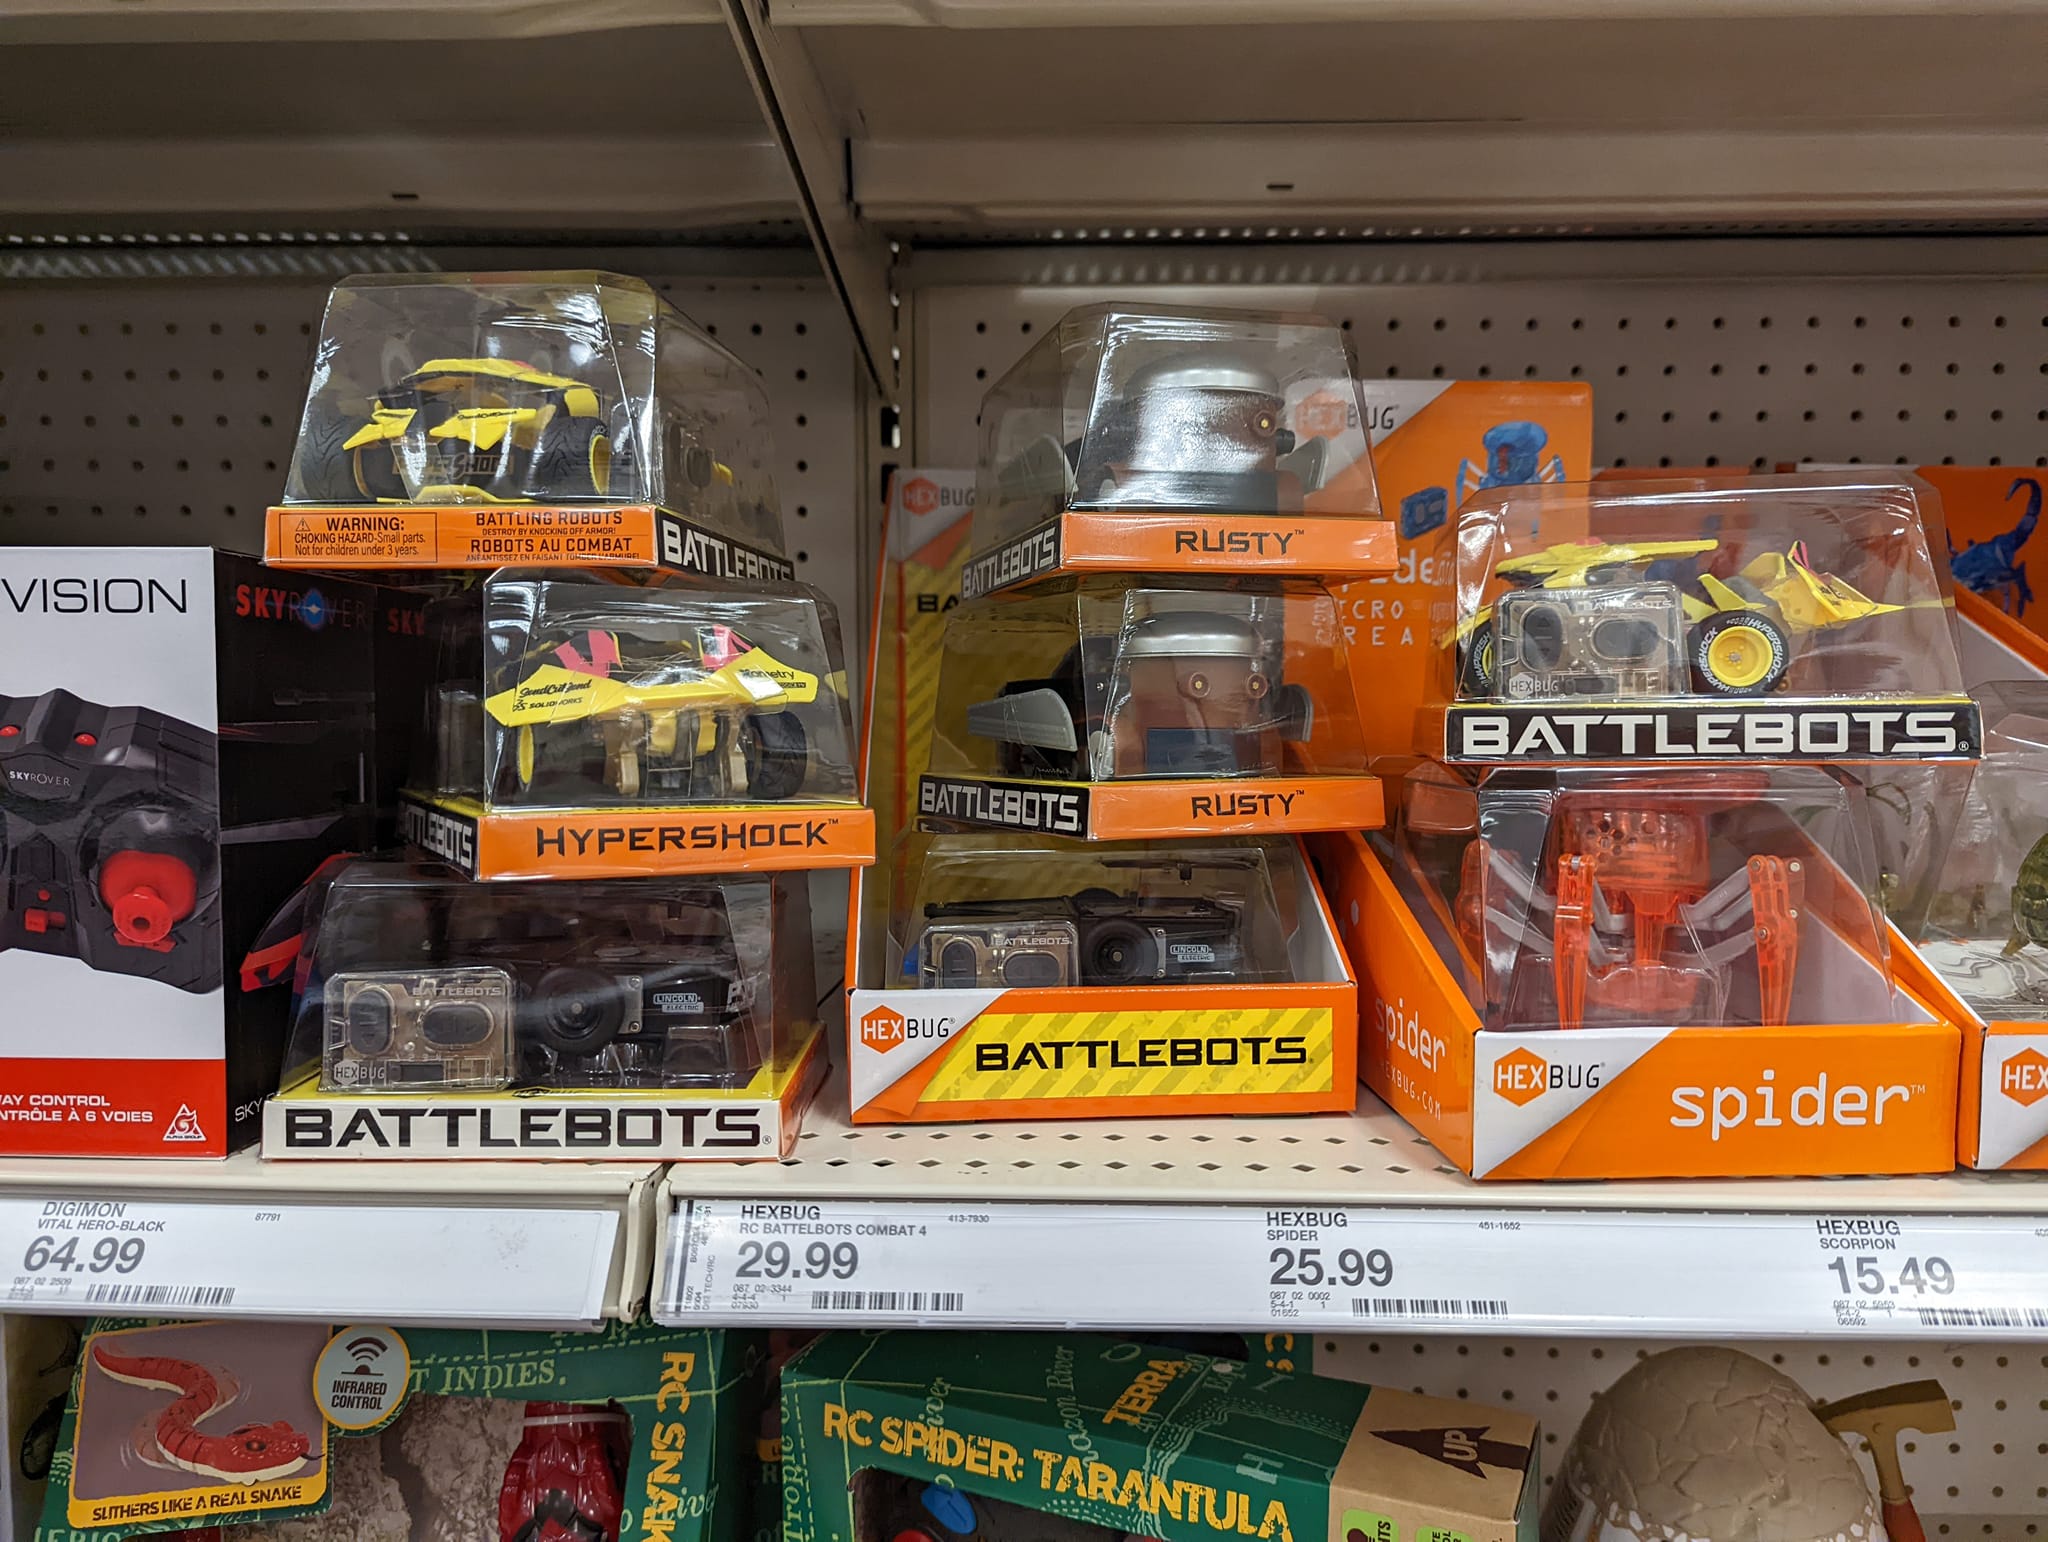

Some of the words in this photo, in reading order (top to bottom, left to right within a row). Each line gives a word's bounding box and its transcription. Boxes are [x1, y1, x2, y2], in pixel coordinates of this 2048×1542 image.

[326, 517, 405, 532] WARNING:
[476, 512, 552, 526] BATTLING
[558, 511, 623, 525] ROBOTS
[295, 533, 336, 544] CHOKING
[482, 528, 517, 536] DESTROY
[529, 527, 568, 536] KNOCKING
[586, 527, 616, 535] ARMOR!
[471, 539, 534, 553] ROBOTS
[540, 538, 560, 552] AU
[566, 537, 633, 551] COMBAT
[1176, 528, 1294, 555] RUSTY
[295, 544, 311, 555] Not
[312, 544, 324, 555] for
[326, 544, 359, 556] children
[361, 545, 386, 556] under
[388, 545, 393, 555] 3
[395, 545, 419, 557] years.
[520, 553, 529, 561] EN
[963, 527, 1056, 598] BATTLEBOTS
[0, 578, 188, 614] VISION
[1748, 618, 1784, 683] HYPERSHOCK
[1698, 627, 1731, 692] HYPERSHOCK
[1511, 679, 1558, 692] HEXBUG
[1462, 711, 1956, 756] BATTLEBOTS
[9, 770, 71, 786] SKYROVER
[921, 781, 1080, 832] BATTLEBOTS
[1191, 792, 1297, 819] RUSTY
[537, 819, 829, 858] HYPERSHOCK
[996, 937, 1070, 945] BATTLEBOTS
[1173, 945, 1208, 953] LINCOLN
[412, 987, 501, 996] BATTLEBOTS
[656, 994, 696, 1003] LINCOLN
[862, 1016, 950, 1040] HEXBUG
[1376, 997, 1446, 1073] spider
[975, 1036, 1308, 1073] BATTLEBOTS
[335, 1066, 385, 1080] HEXBUG
[1497, 1064, 1600, 1089] HEXBUG
[29, 1095, 111, 1106] CONTROL
[1669, 1069, 1911, 1141] spider
[67, 1108, 81, 1122] À
[85, 1110, 97, 1122] 6
[102, 1110, 153, 1122] VOIES
[285, 1107, 760, 1148] BATTLEBOTS
[42, 1201, 127, 1218] DIGIMON
[255, 1213, 281, 1222] 87791
[741, 1205, 821, 1220] HEXBUG
[37, 1219, 73, 1230] VITAL
[77, 1220, 165, 1232] HERO-BLACK
[948, 1214, 990, 1223] 413-7930
[1267, 1212, 1348, 1227] HEXBUG
[1478, 1221, 1521, 1231] 451-1652
[739, 1223, 759, 1234] RC
[763, 1223, 852, 1236] BATTELBOTS
[856, 1224, 916, 1236] COMBAT
[918, 1225, 927, 1236] 4
[1267, 1229, 1319, 1241] SPIDER
[1816, 1219, 1901, 1235] HEXBUG
[1819, 1237, 1896, 1250] SCORPION
[23, 1235, 146, 1274] 64.99
[736, 1241, 859, 1279] 29.99
[1270, 1248, 1393, 1287] 25.99
[1827, 1256, 1956, 1295] 15.49
[1270, 1291, 1287, 1300] 087
[1292, 1291, 1303, 1300] 02
[1270, 1300, 1294, 1308] 5-4-1
[437, 1358, 567, 1396] INDIES.
[657, 1352, 695, 1414] RC
[332, 1380, 388, 1396] INFRARED
[1102, 1360, 1186, 1425] TERRA
[331, 1395, 383, 1410] CONTROL
[1443, 1430, 1480, 1462] UP
[823, 1402, 873, 1447] RC
[880, 1415, 1025, 1482] SPIDER:
[1033, 1448, 1295, 1542] TARANTULA
[92, 1501, 159, 1521] SLITHERS
[162, 1497, 193, 1513] LIKE
[195, 1496, 207, 1509] A
[210, 1491, 247, 1507] REAL
[250, 1486, 302, 1504] SNAKE
